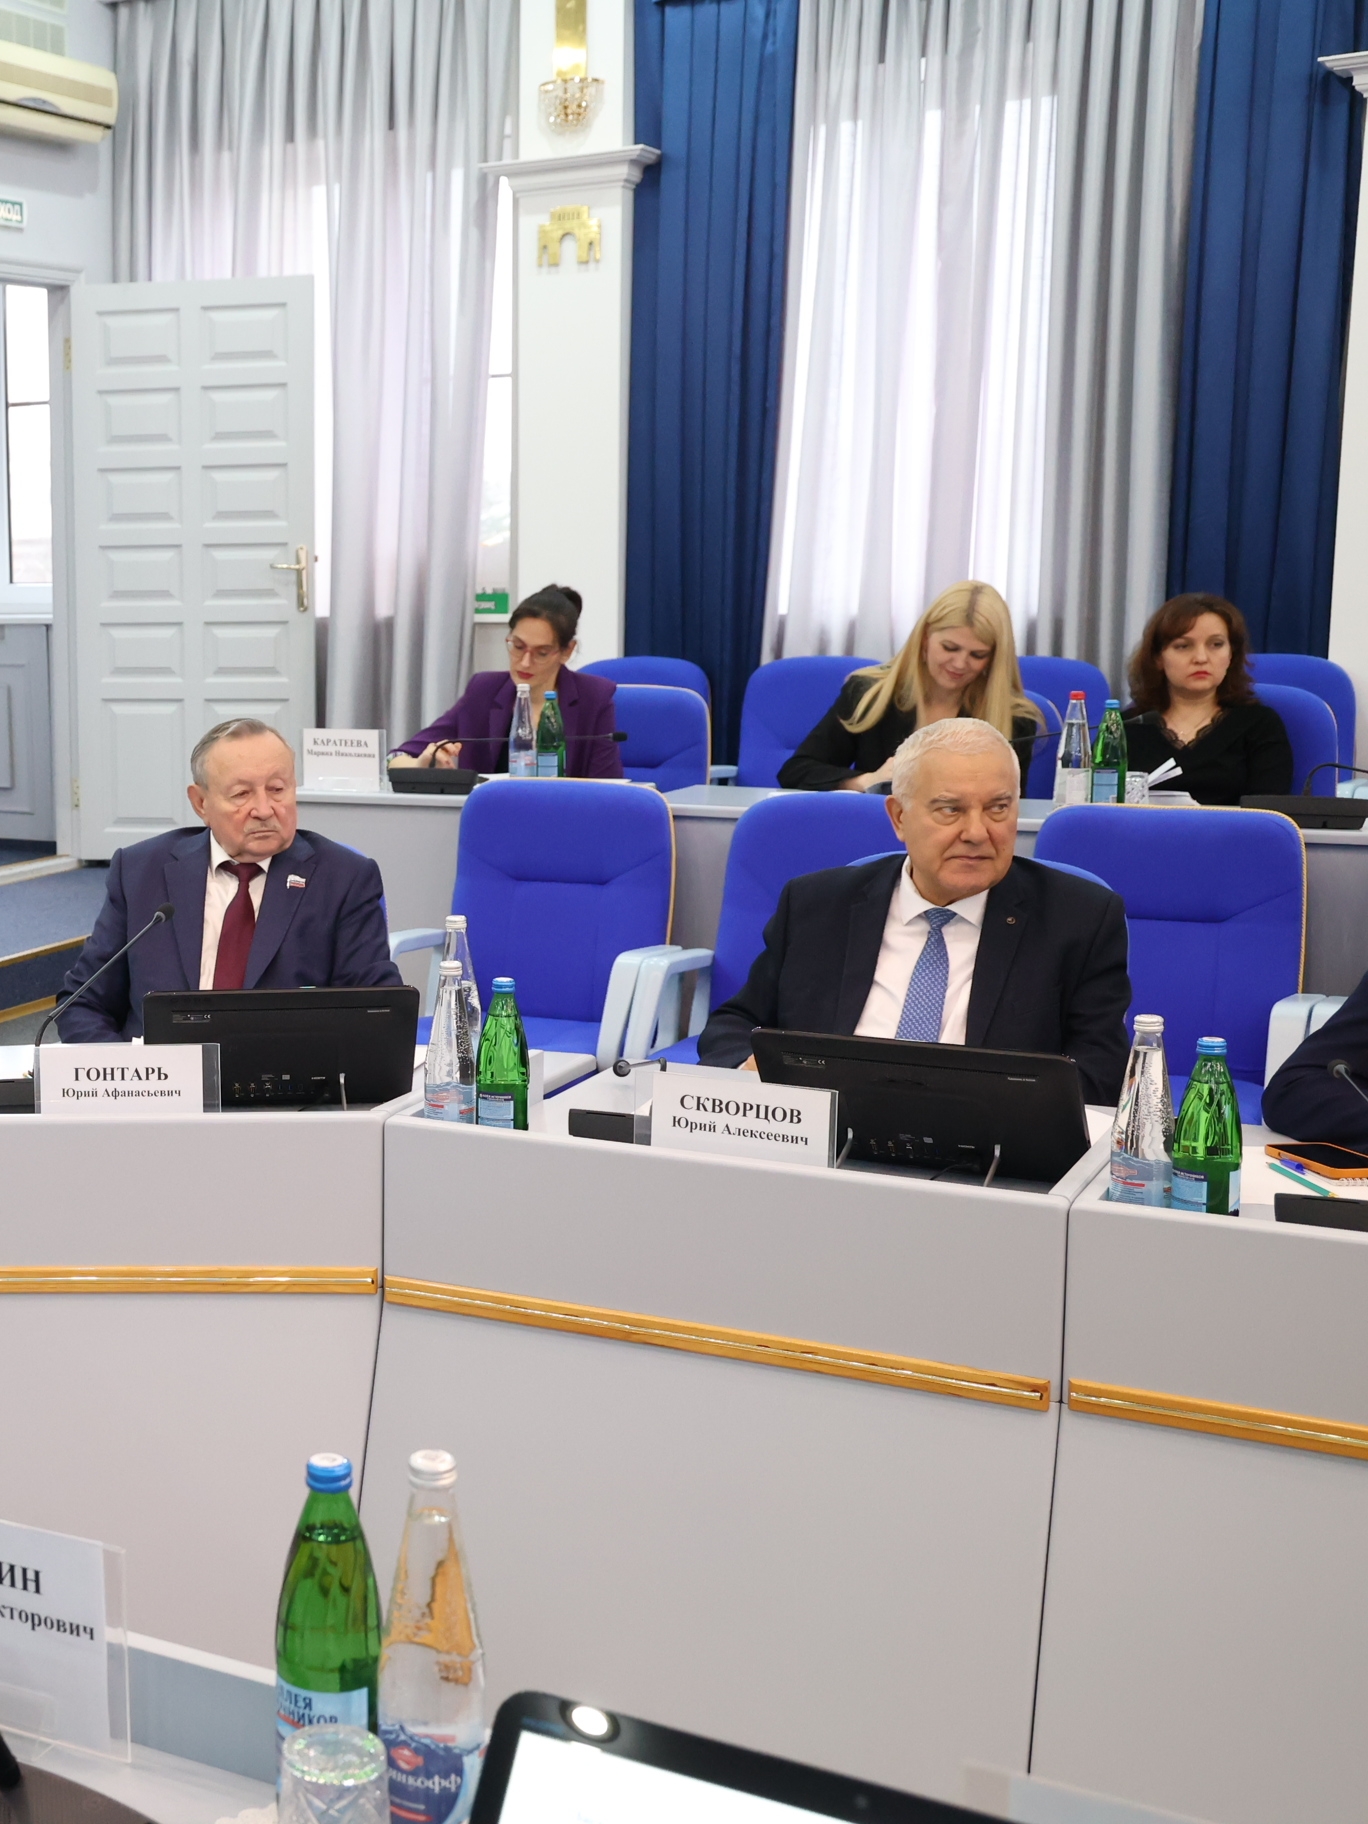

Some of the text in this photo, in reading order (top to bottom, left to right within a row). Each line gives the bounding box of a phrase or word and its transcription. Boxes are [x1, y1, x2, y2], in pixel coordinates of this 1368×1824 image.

[313, 737, 369, 748] КАРАТЕЕВА
[73, 1066, 169, 1082] ГОНТАРЬ
[62, 1087, 182, 1100] Юрий Афанасьевич
[679, 1094, 802, 1124] СКВОРЦОВ
[671, 1115, 809, 1146] Юрий Алексеевич
